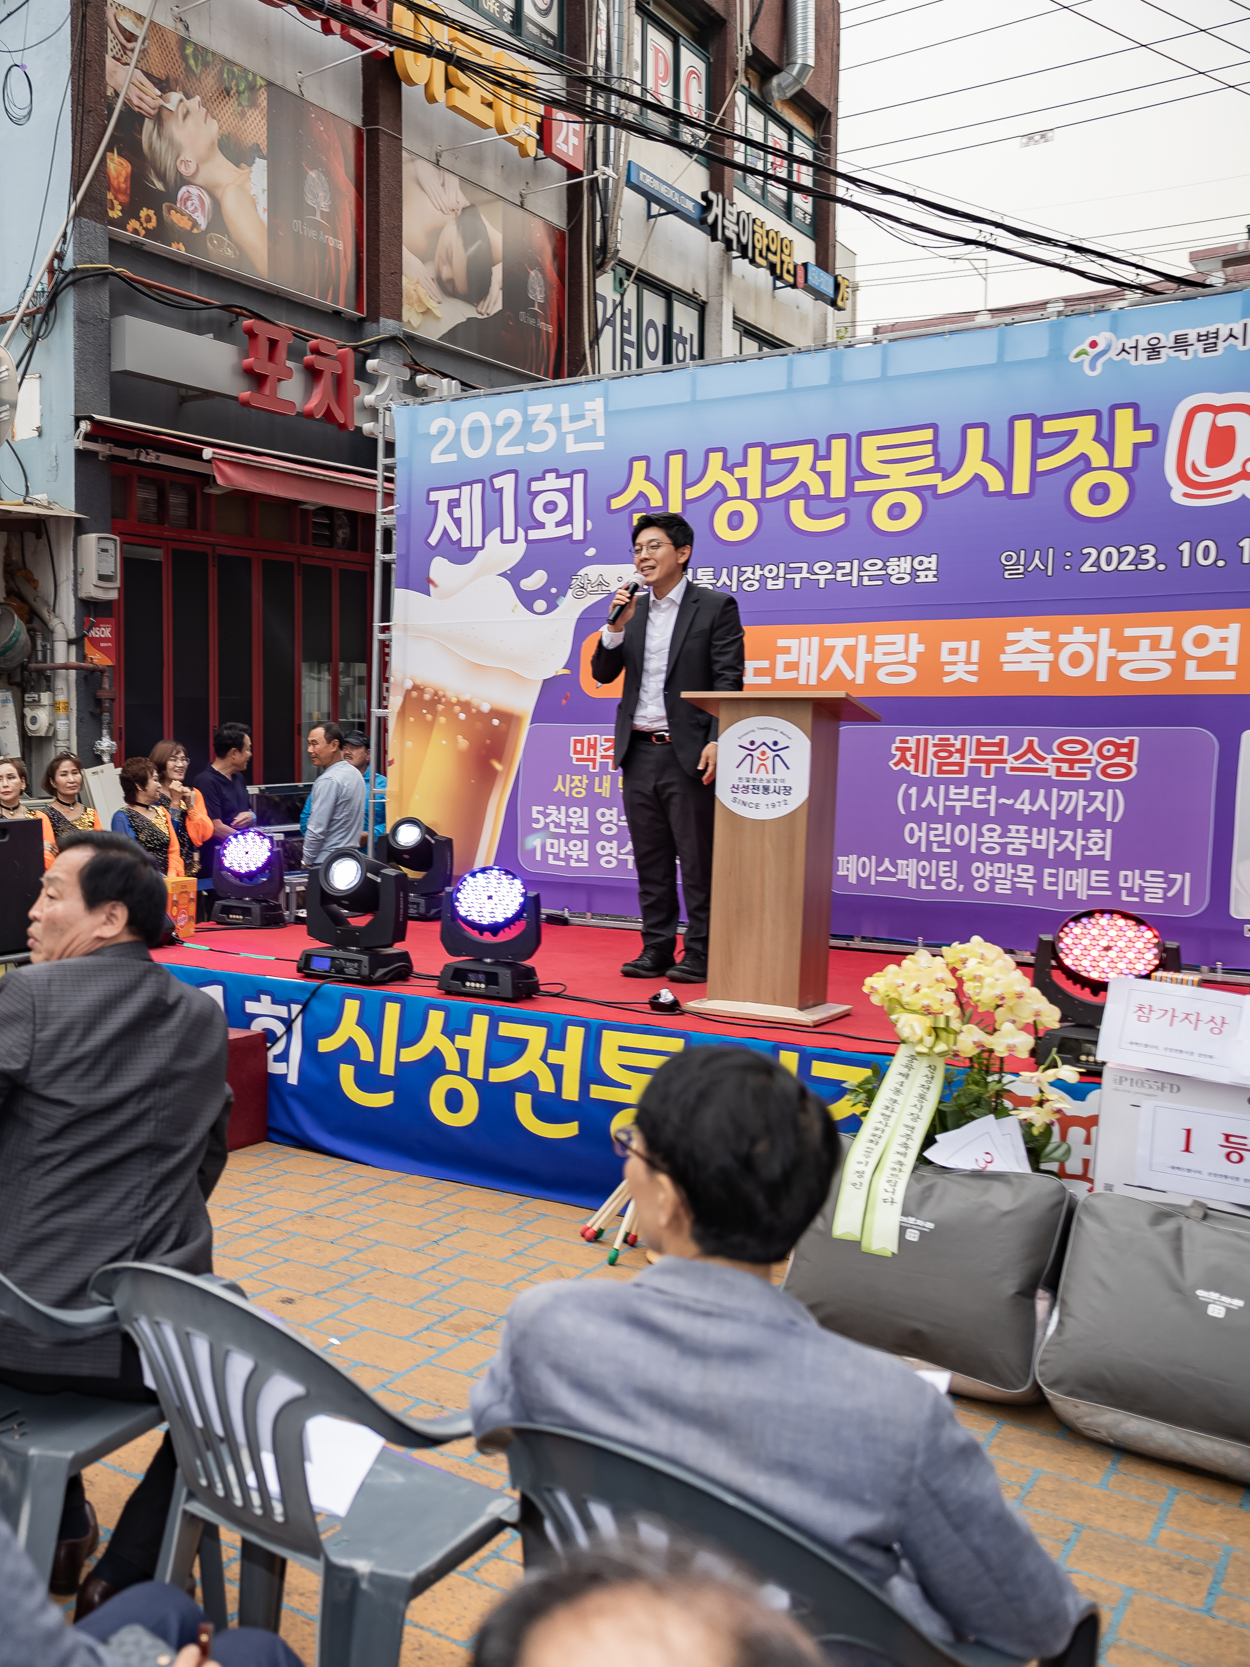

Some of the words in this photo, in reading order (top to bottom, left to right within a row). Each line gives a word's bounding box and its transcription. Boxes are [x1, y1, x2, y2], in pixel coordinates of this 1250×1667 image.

[555, 108, 580, 155] 2F
[1115, 323, 1249, 363] 서울특별시
[238, 318, 361, 432] 포차
[429, 397, 606, 465] 2023년
[609, 407, 1154, 542] 신성전통시장
[426, 472, 587, 549] 제1회
[570, 573, 611, 599] 장소
[683, 553, 939, 593] 통시장입구우리은행옆
[999, 547, 1055, 580] 일시
[1078, 543, 1167, 574] 2023.
[1177, 540, 1226, 568] 10.
[939, 639, 981, 684] 및
[999, 623, 1241, 684] 축하공연
[889, 734, 1140, 782] 체험부스운영
[553, 774, 589, 798] 시장
[594, 774, 611, 798] 내
[730, 783, 793, 796] 신성전통시장
[730, 796, 761, 810] SINCE
[897, 783, 1125, 822] (1시부터~4시까지)
[531, 804, 590, 834] 5천원
[533, 838, 590, 867] 1만원
[903, 821, 1113, 861] 어린이용품바자회
[836, 854, 964, 893] 페이스페인팅,
[972, 860, 1037, 896] 양말목
[1043, 867, 1112, 900] 티메트
[1119, 869, 1191, 906] 만들기
[1132, 1002, 1230, 1036] 참가자상
[1217, 1131, 1250, 1165] 등
